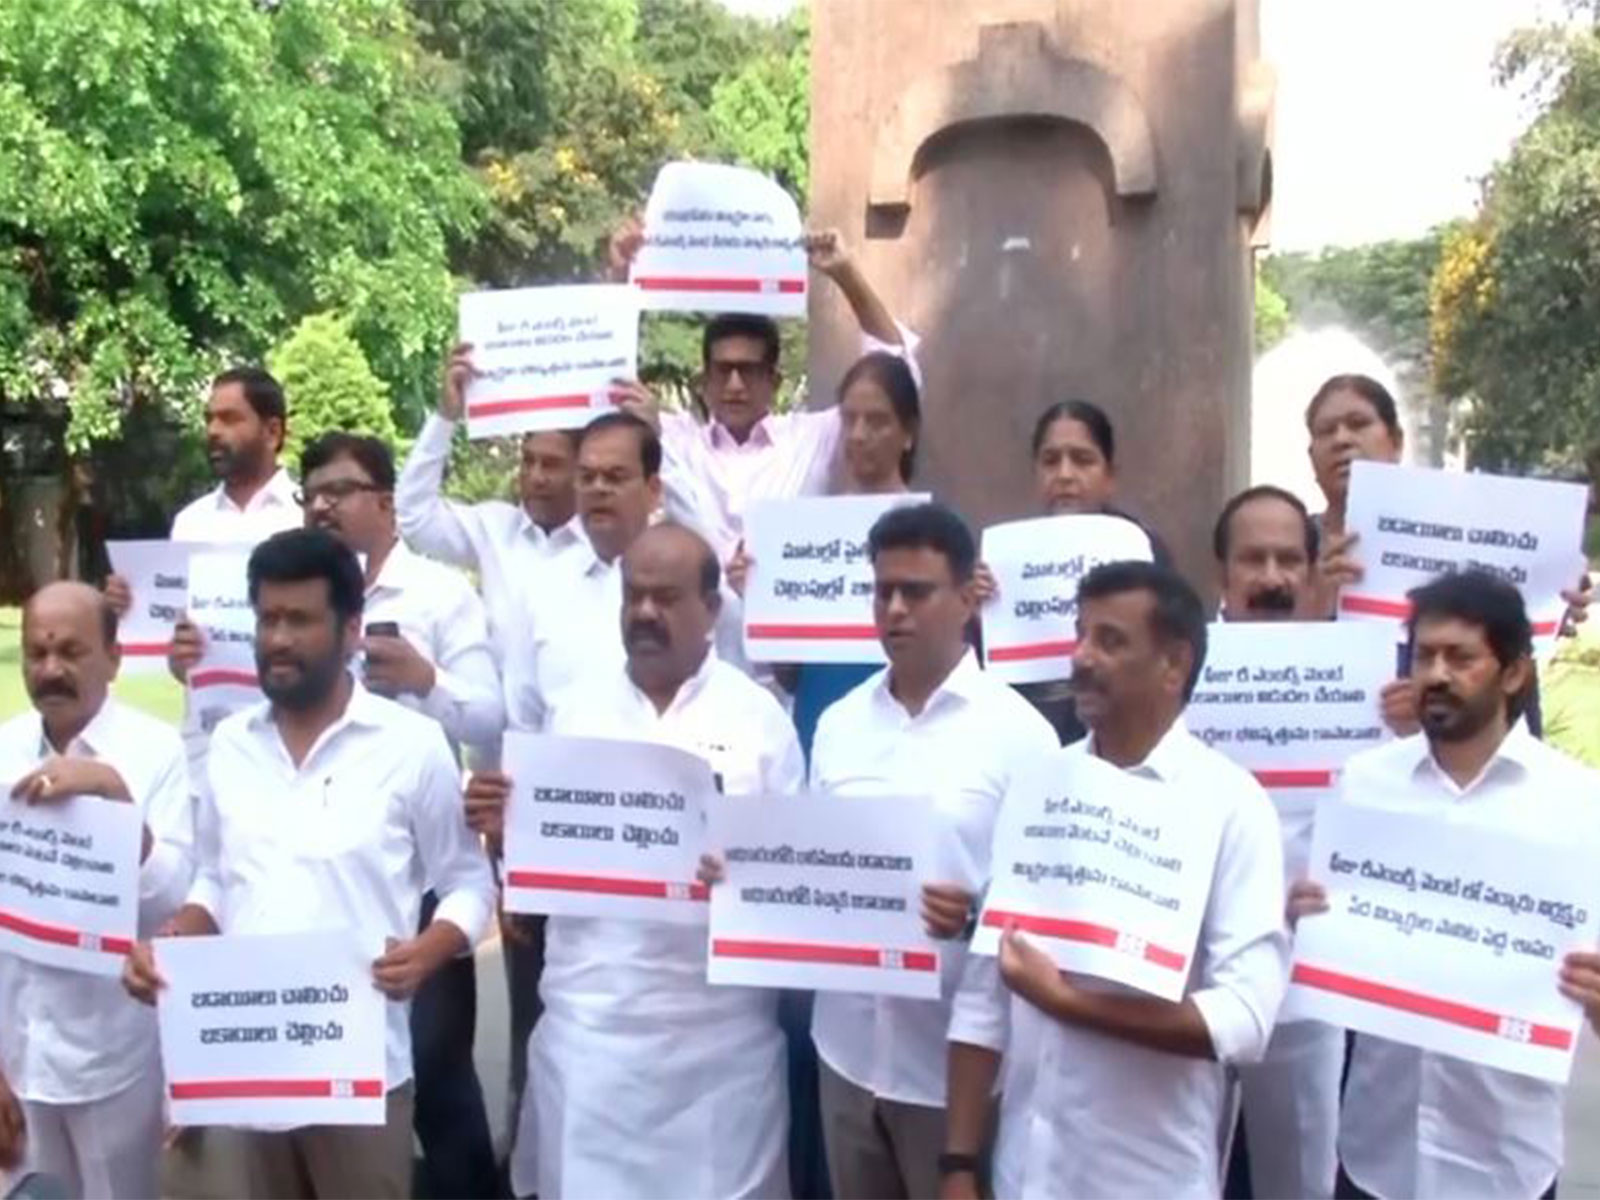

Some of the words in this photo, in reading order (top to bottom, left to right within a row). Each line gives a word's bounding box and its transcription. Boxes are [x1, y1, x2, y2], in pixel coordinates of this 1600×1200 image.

[1467, 527, 1538, 551] చాలించు
[1257, 689, 1310, 703] విడుదల
[1314, 686, 1365, 703] చేయాలి
[620, 791, 685, 811] చాలించు
[622, 824, 678, 849] చెల్లించు
[1329, 851, 1358, 873] ఫీజు
[1484, 889, 1536, 915] సర్కారు
[1538, 898, 1588, 928] నిర్లక్ష్యం
[1348, 896, 1370, 918] పేద
[1436, 921, 1479, 942] పాలిట
[1482, 927, 1508, 956] పెద్ద
[1511, 936, 1555, 960] శాపం
[281, 983, 348, 1004] చాలించు
[286, 1021, 343, 1045] చెల్లించు
